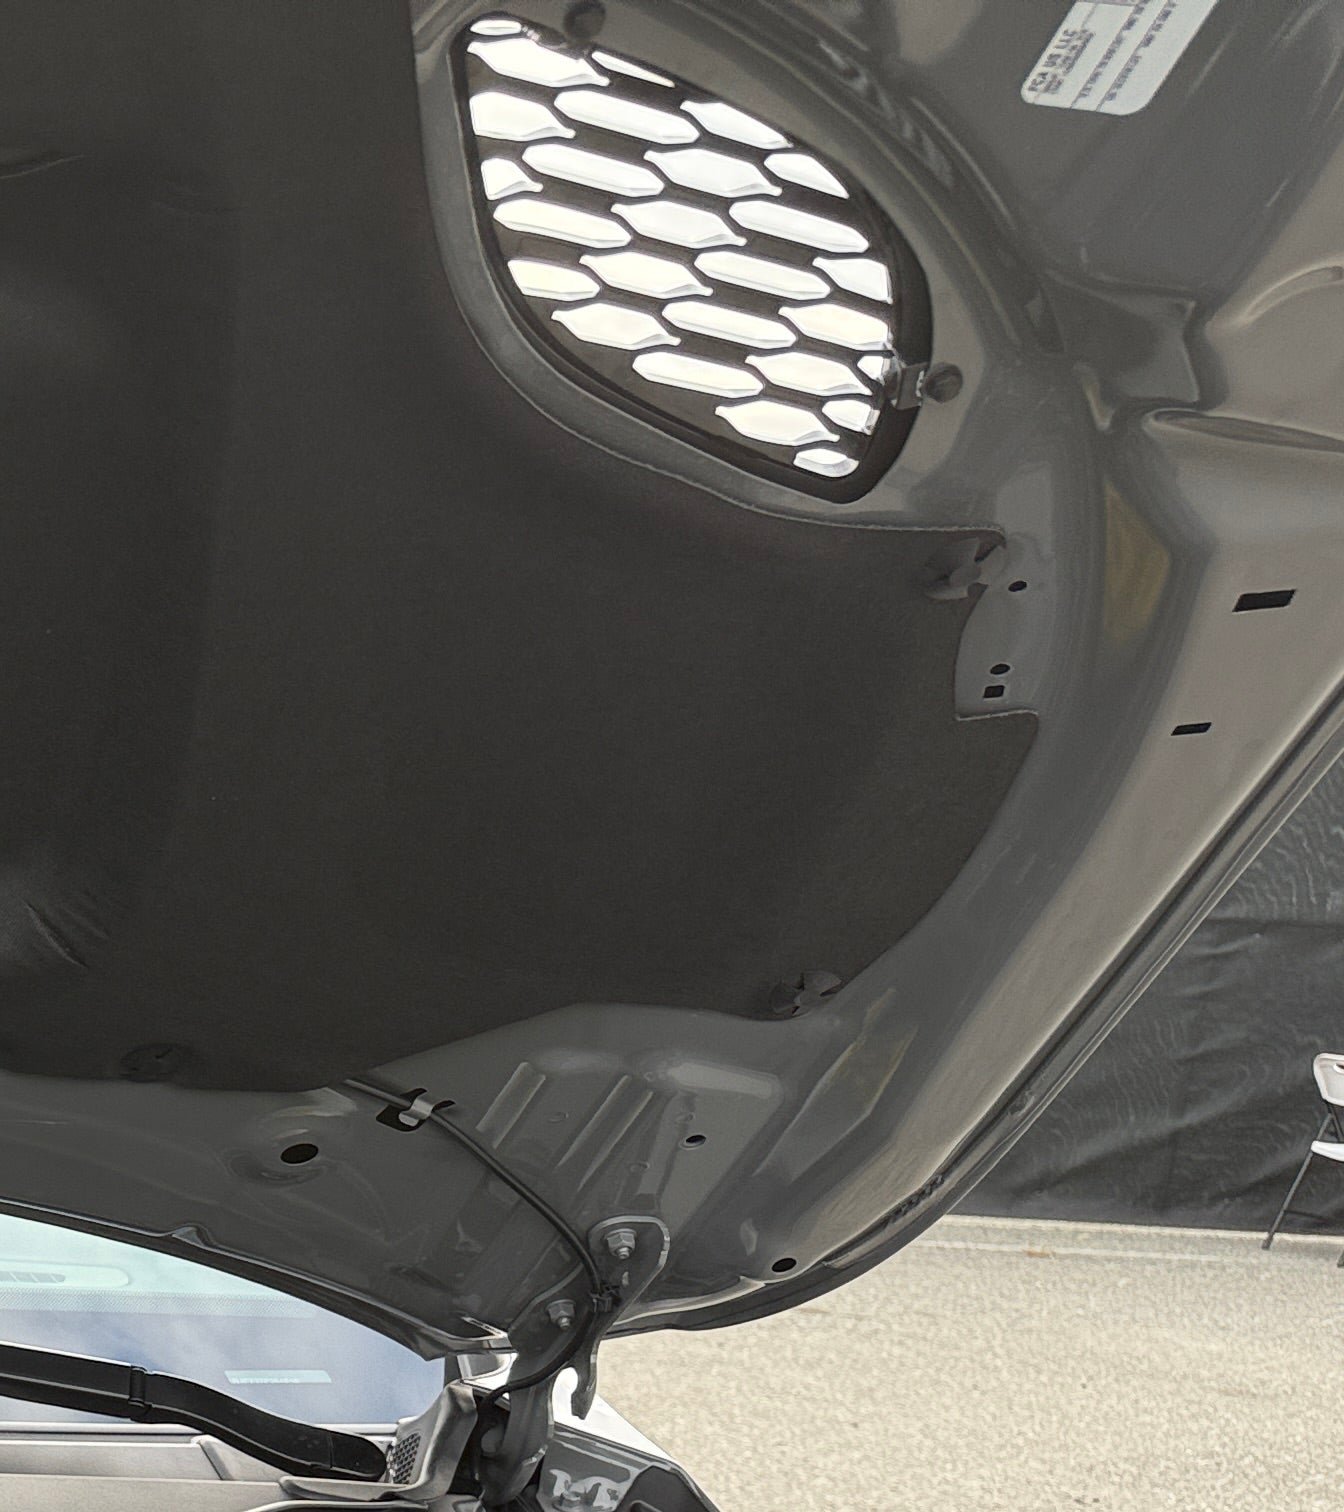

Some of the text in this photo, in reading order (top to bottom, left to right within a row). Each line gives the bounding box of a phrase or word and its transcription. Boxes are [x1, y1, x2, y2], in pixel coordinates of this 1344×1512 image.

[1028, 30, 1077, 92] FCA US LLC
